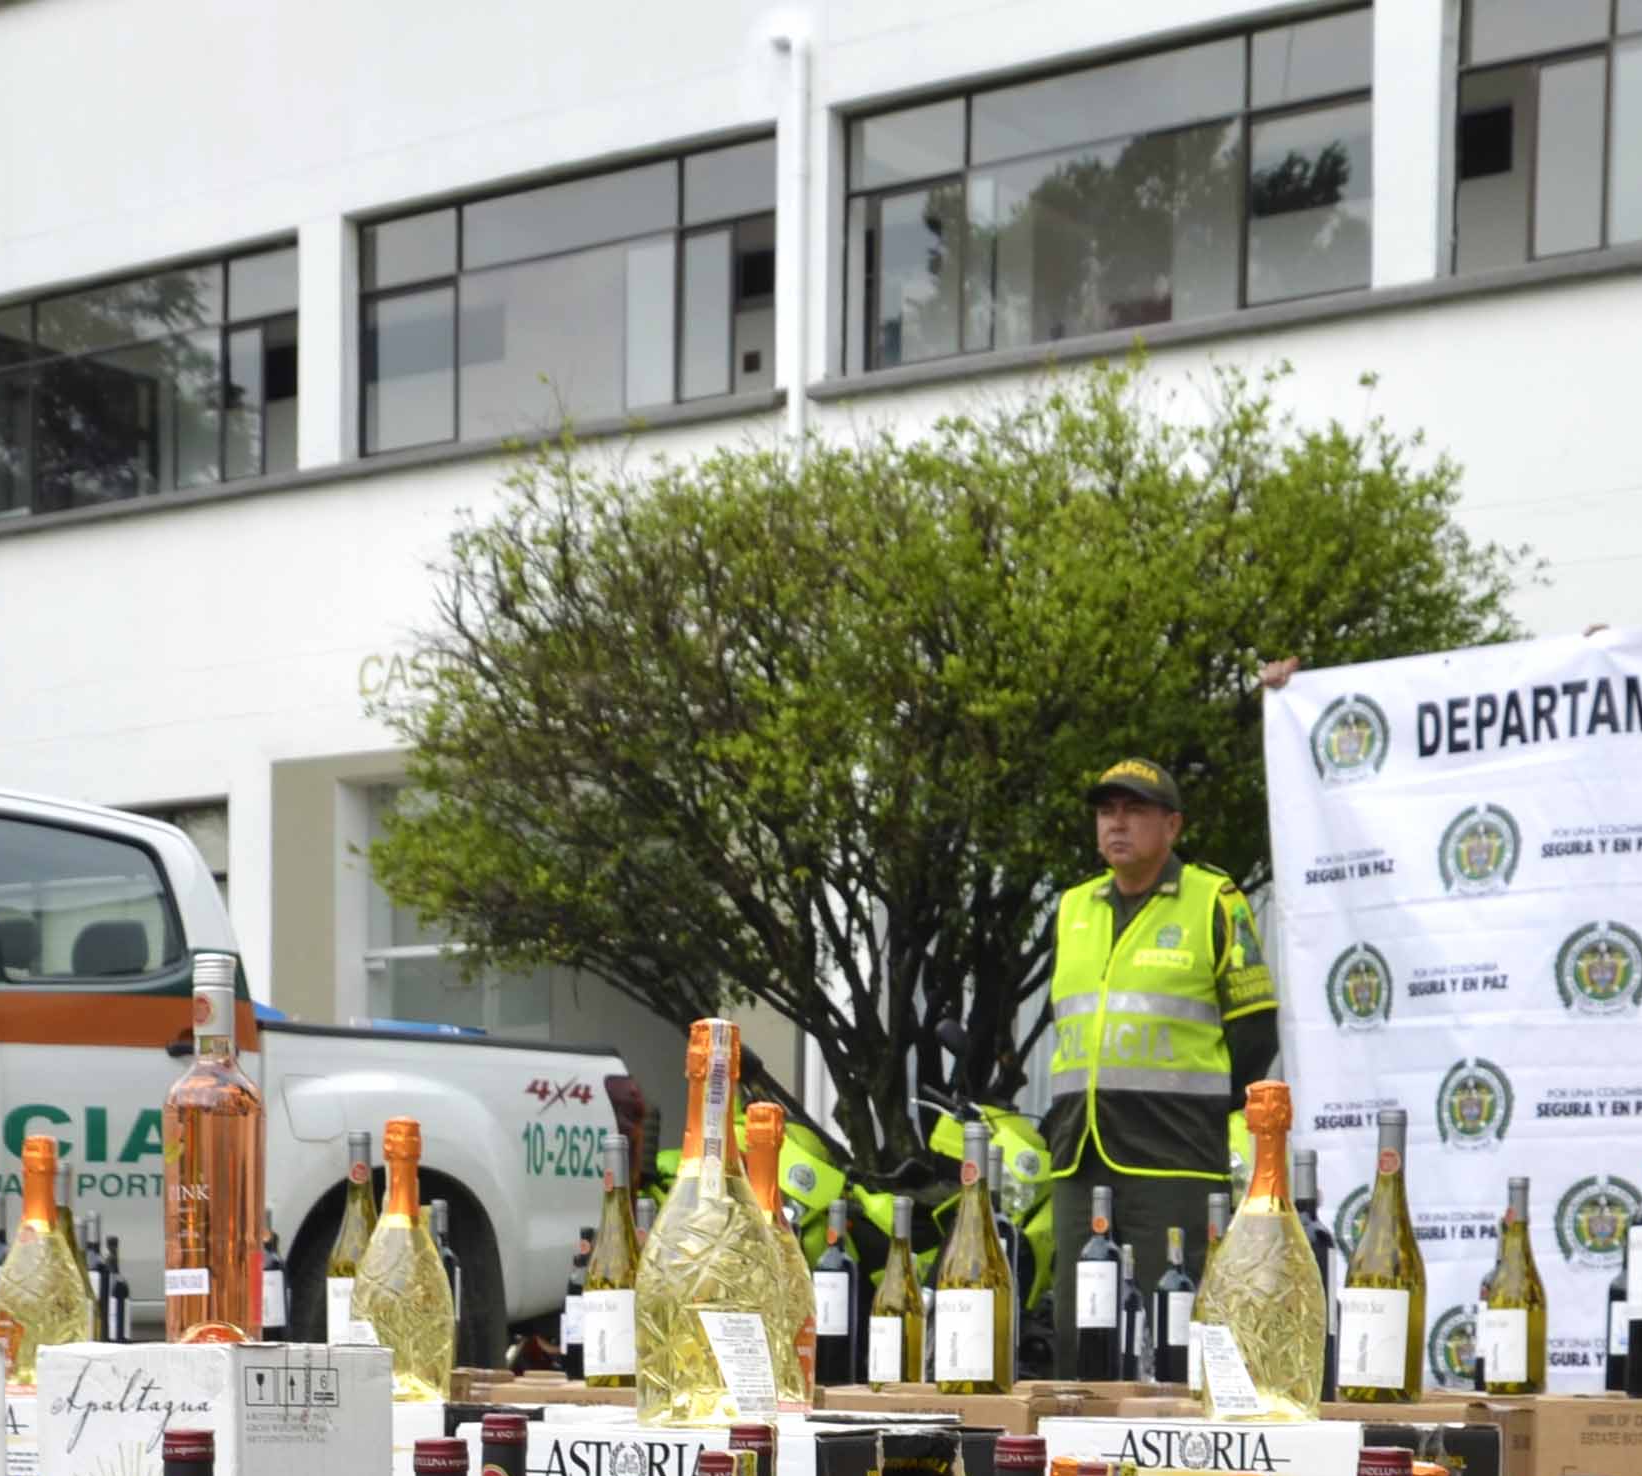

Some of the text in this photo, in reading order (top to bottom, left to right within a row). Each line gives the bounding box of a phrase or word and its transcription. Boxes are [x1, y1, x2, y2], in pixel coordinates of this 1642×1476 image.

[1541, 839, 1595, 859] SEGURA
[1598, 839, 1608, 854] Y
[1614, 837, 1632, 853] EN
[1537, 1101, 1593, 1119] SEGURA
[1598, 1101, 1608, 1115] Y
[1611, 1100, 1633, 1115] EN
[1101, 1429, 1291, 1471] ASTORIA
